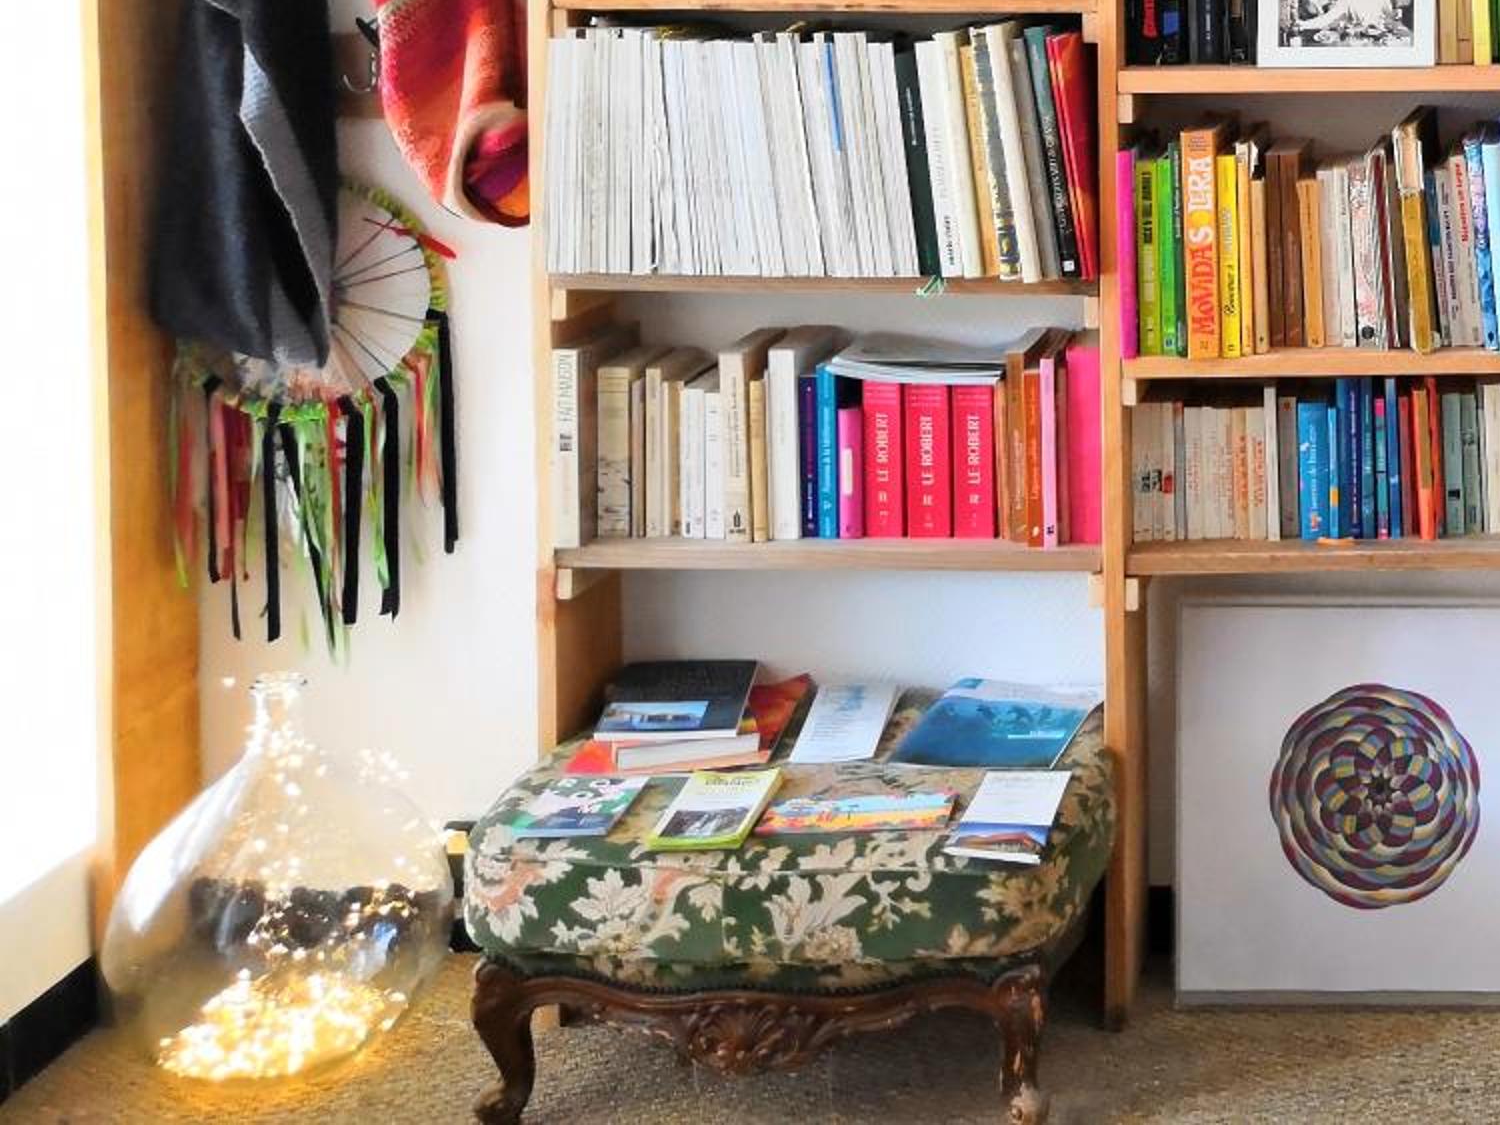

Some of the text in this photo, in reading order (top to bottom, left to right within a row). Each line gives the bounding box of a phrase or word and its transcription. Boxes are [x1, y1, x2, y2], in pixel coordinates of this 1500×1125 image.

[875, 412, 889, 482] LE ROBERT
[920, 414, 935, 486] LE ROBERT
[966, 414, 981, 485] LE ROBERT
